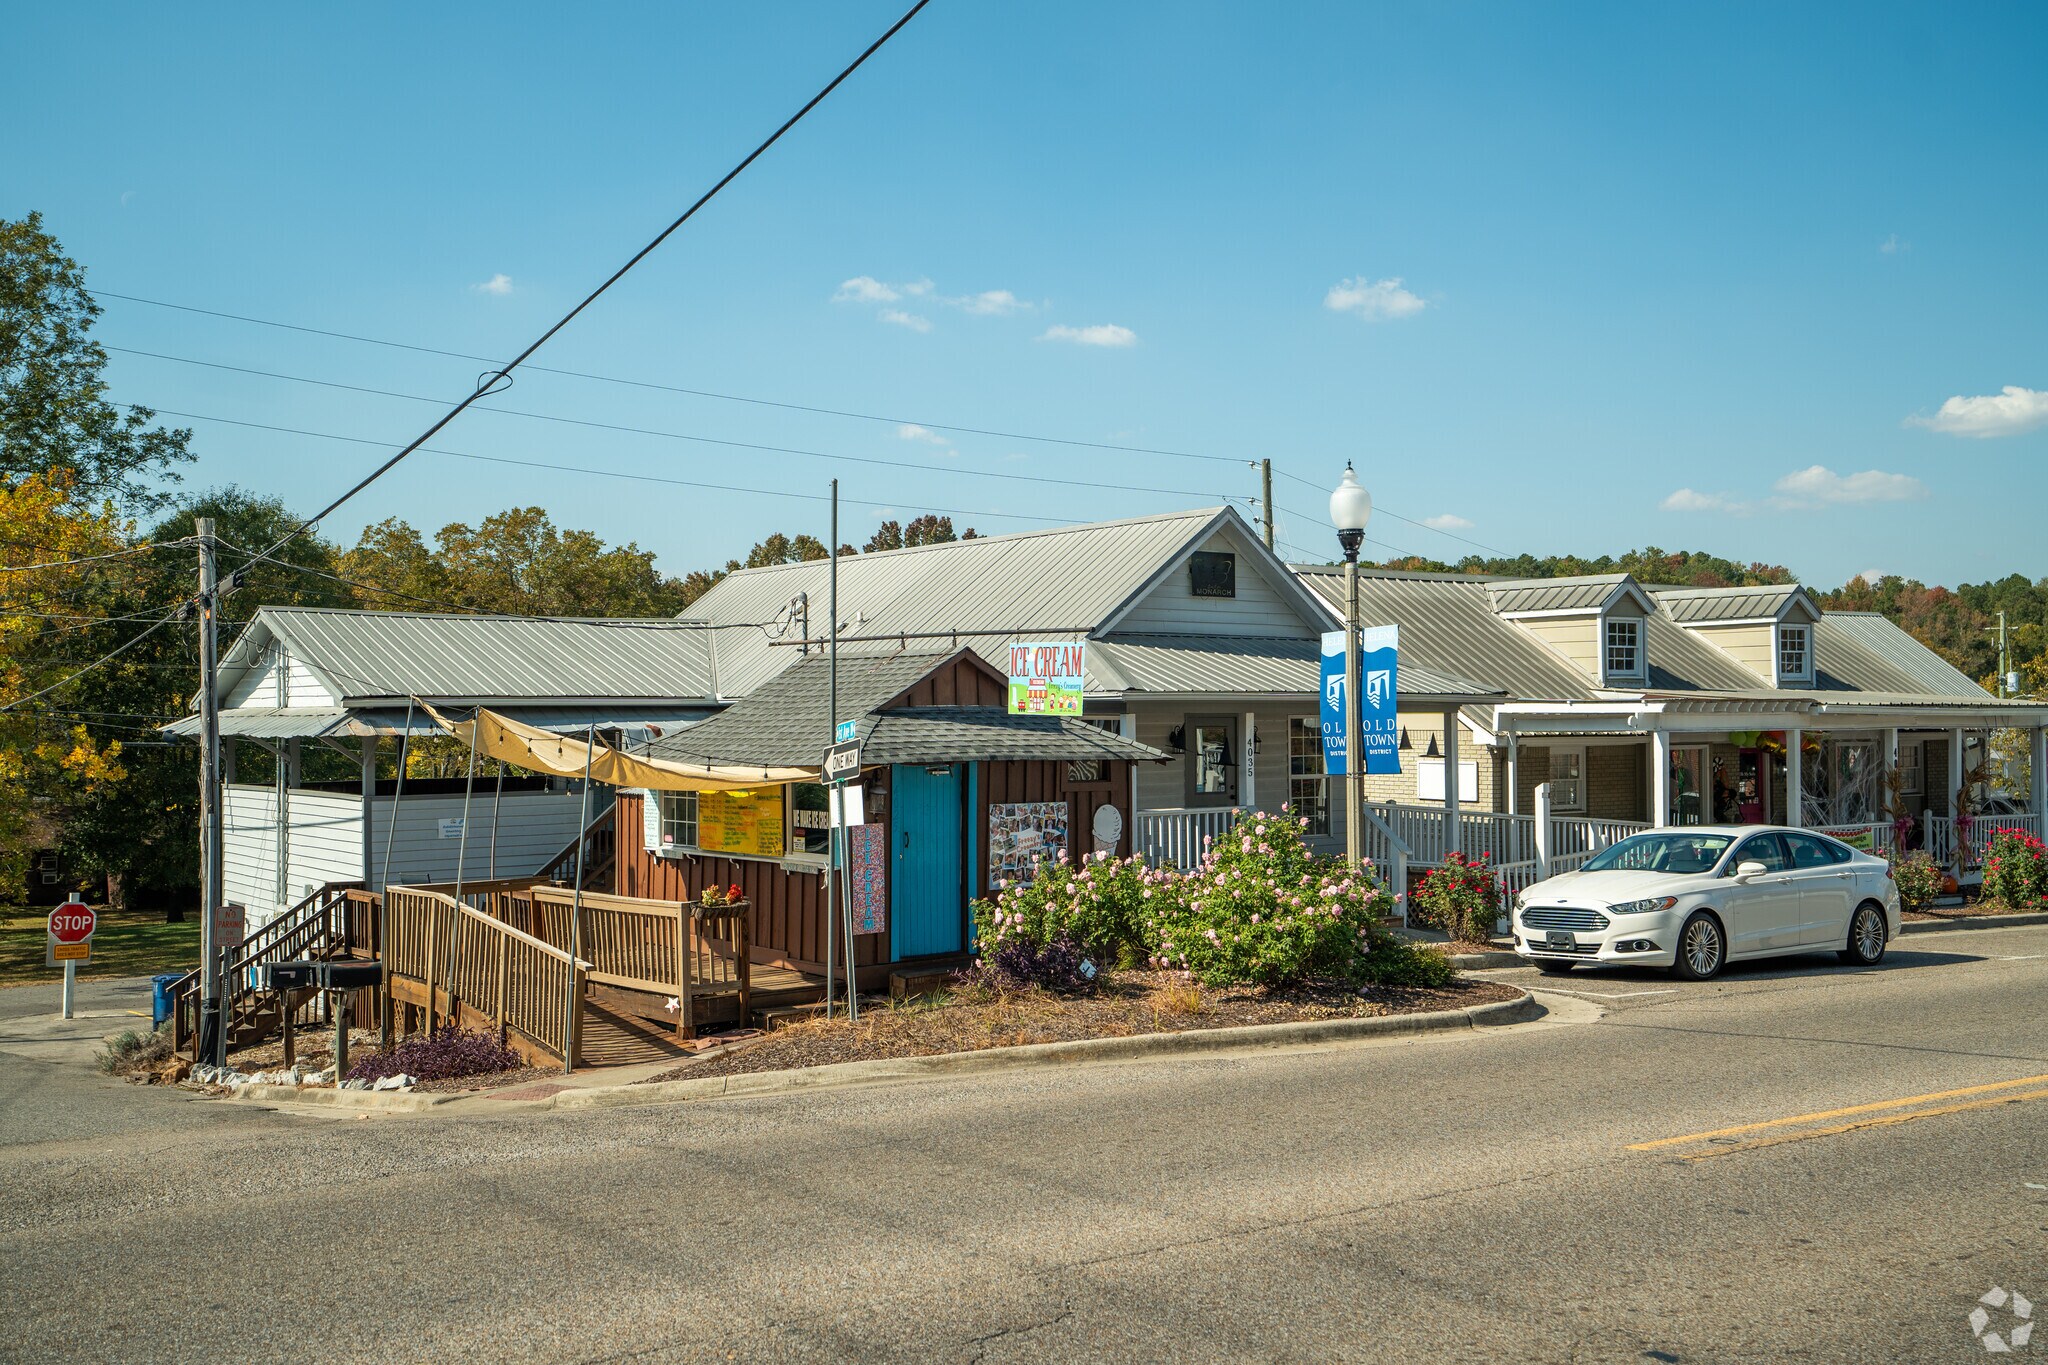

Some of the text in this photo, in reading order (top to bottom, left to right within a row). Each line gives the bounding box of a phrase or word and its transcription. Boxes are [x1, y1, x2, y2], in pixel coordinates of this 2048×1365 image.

[1196, 588, 1232, 596] MONARCH
[1010, 646, 1083, 682] ICE CREAM
[1323, 722, 1342, 733] OL
[1363, 719, 1395, 732] OLD
[1324, 736, 1346, 748] TOW
[1364, 733, 1395, 746] TOWN
[833, 750, 857, 770] ONE WAY
[800, 810, 811, 828] MAKE
[1018, 834, 1040, 844] Freezy's
[1017, 841, 1041, 852] Creamery
[864, 869, 874, 930] CREAM
[53, 916, 92, 930] STOP
